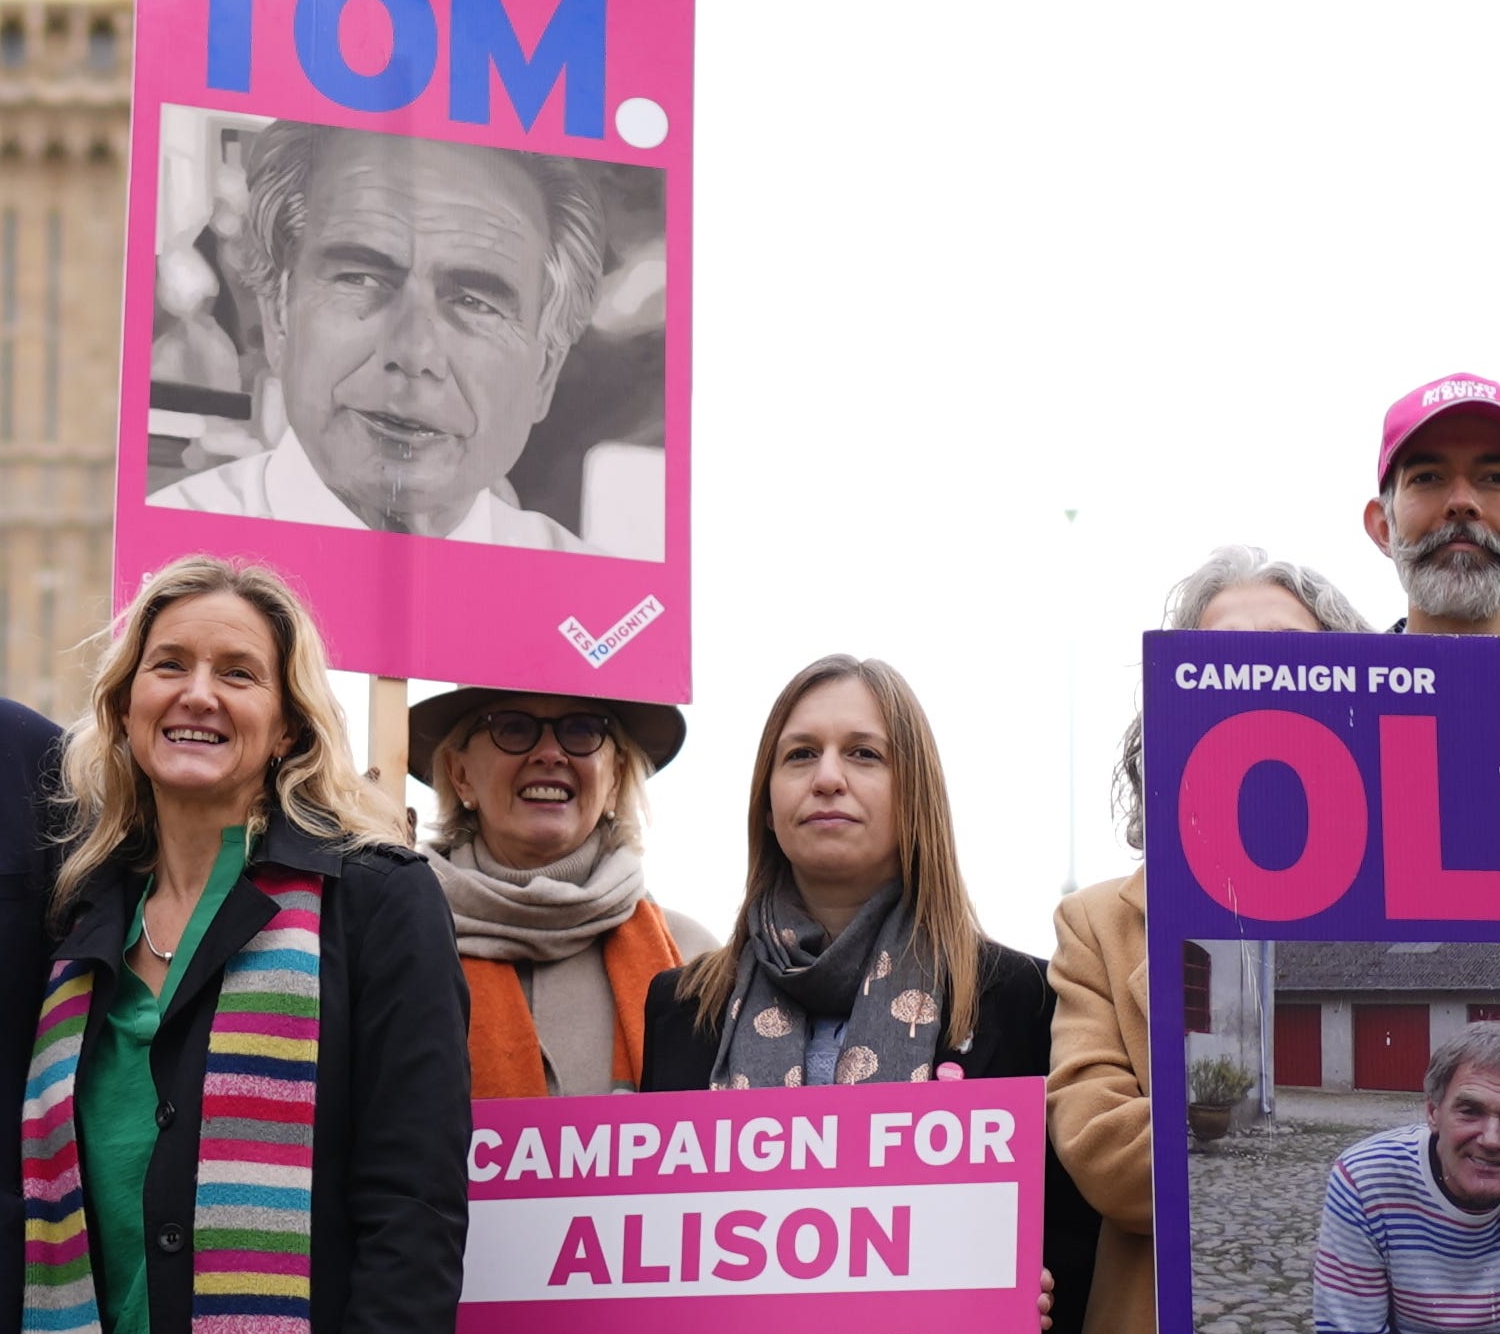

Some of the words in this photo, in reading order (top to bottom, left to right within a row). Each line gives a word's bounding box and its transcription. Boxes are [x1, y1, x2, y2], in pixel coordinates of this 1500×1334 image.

[1176, 663, 1355, 691] CAMPAIGN
[1369, 667, 1434, 693] FOR
[468, 1115, 838, 1181] CAMPAIGN
[870, 1109, 1014, 1167] FOR
[548, 1206, 911, 1287] ALISON
